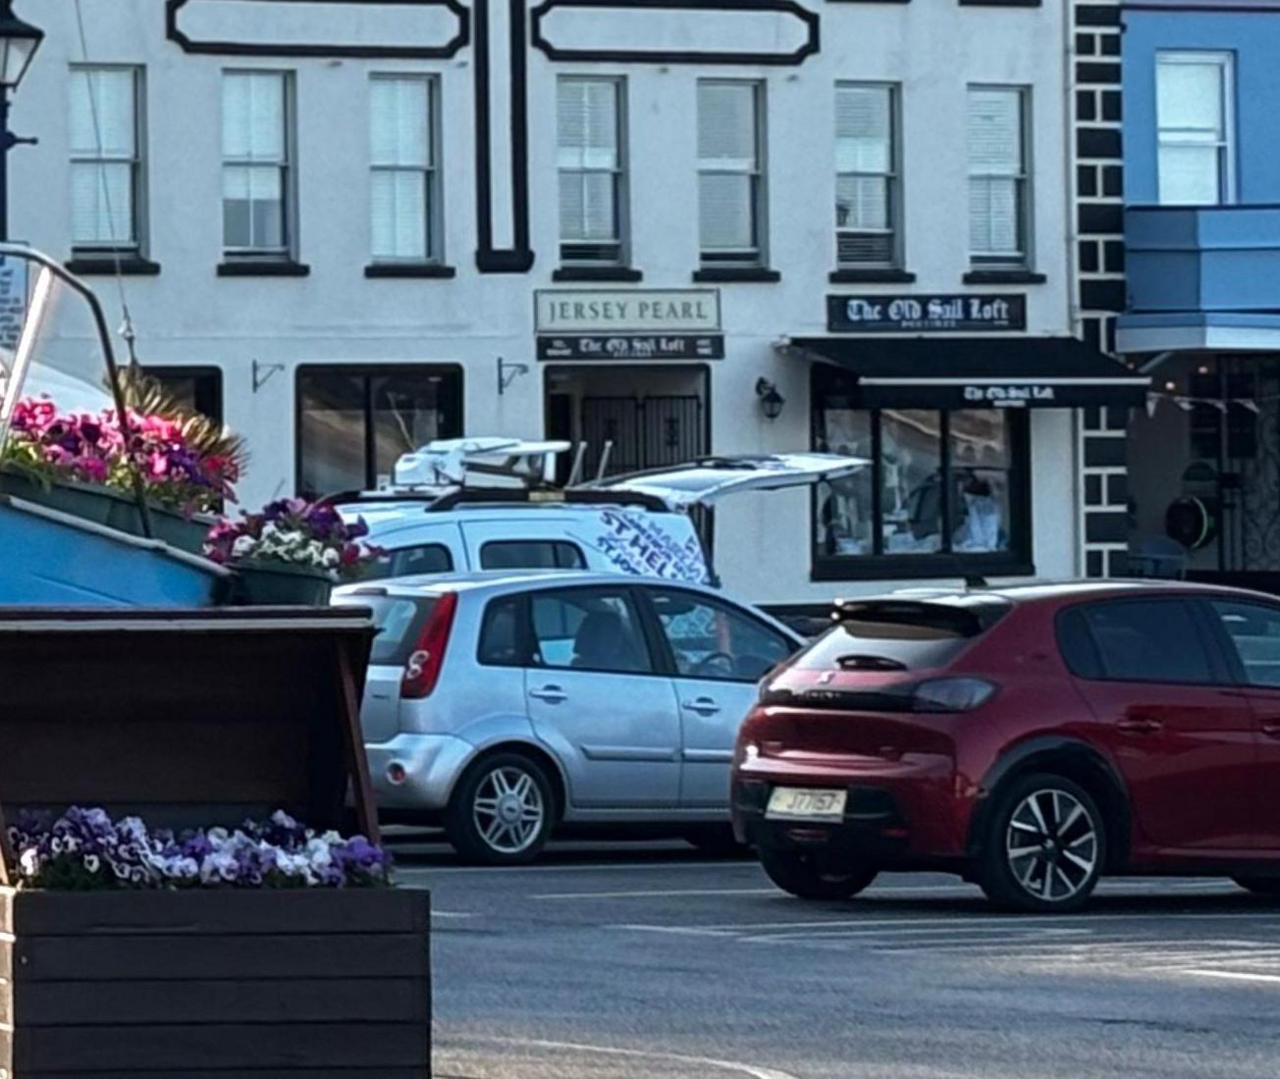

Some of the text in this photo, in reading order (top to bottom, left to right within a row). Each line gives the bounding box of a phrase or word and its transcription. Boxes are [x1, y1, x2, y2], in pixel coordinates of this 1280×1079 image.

[548, 301, 708, 323] JERSEY PEARL
[847, 299, 1009, 321] The Old Sail Loft
